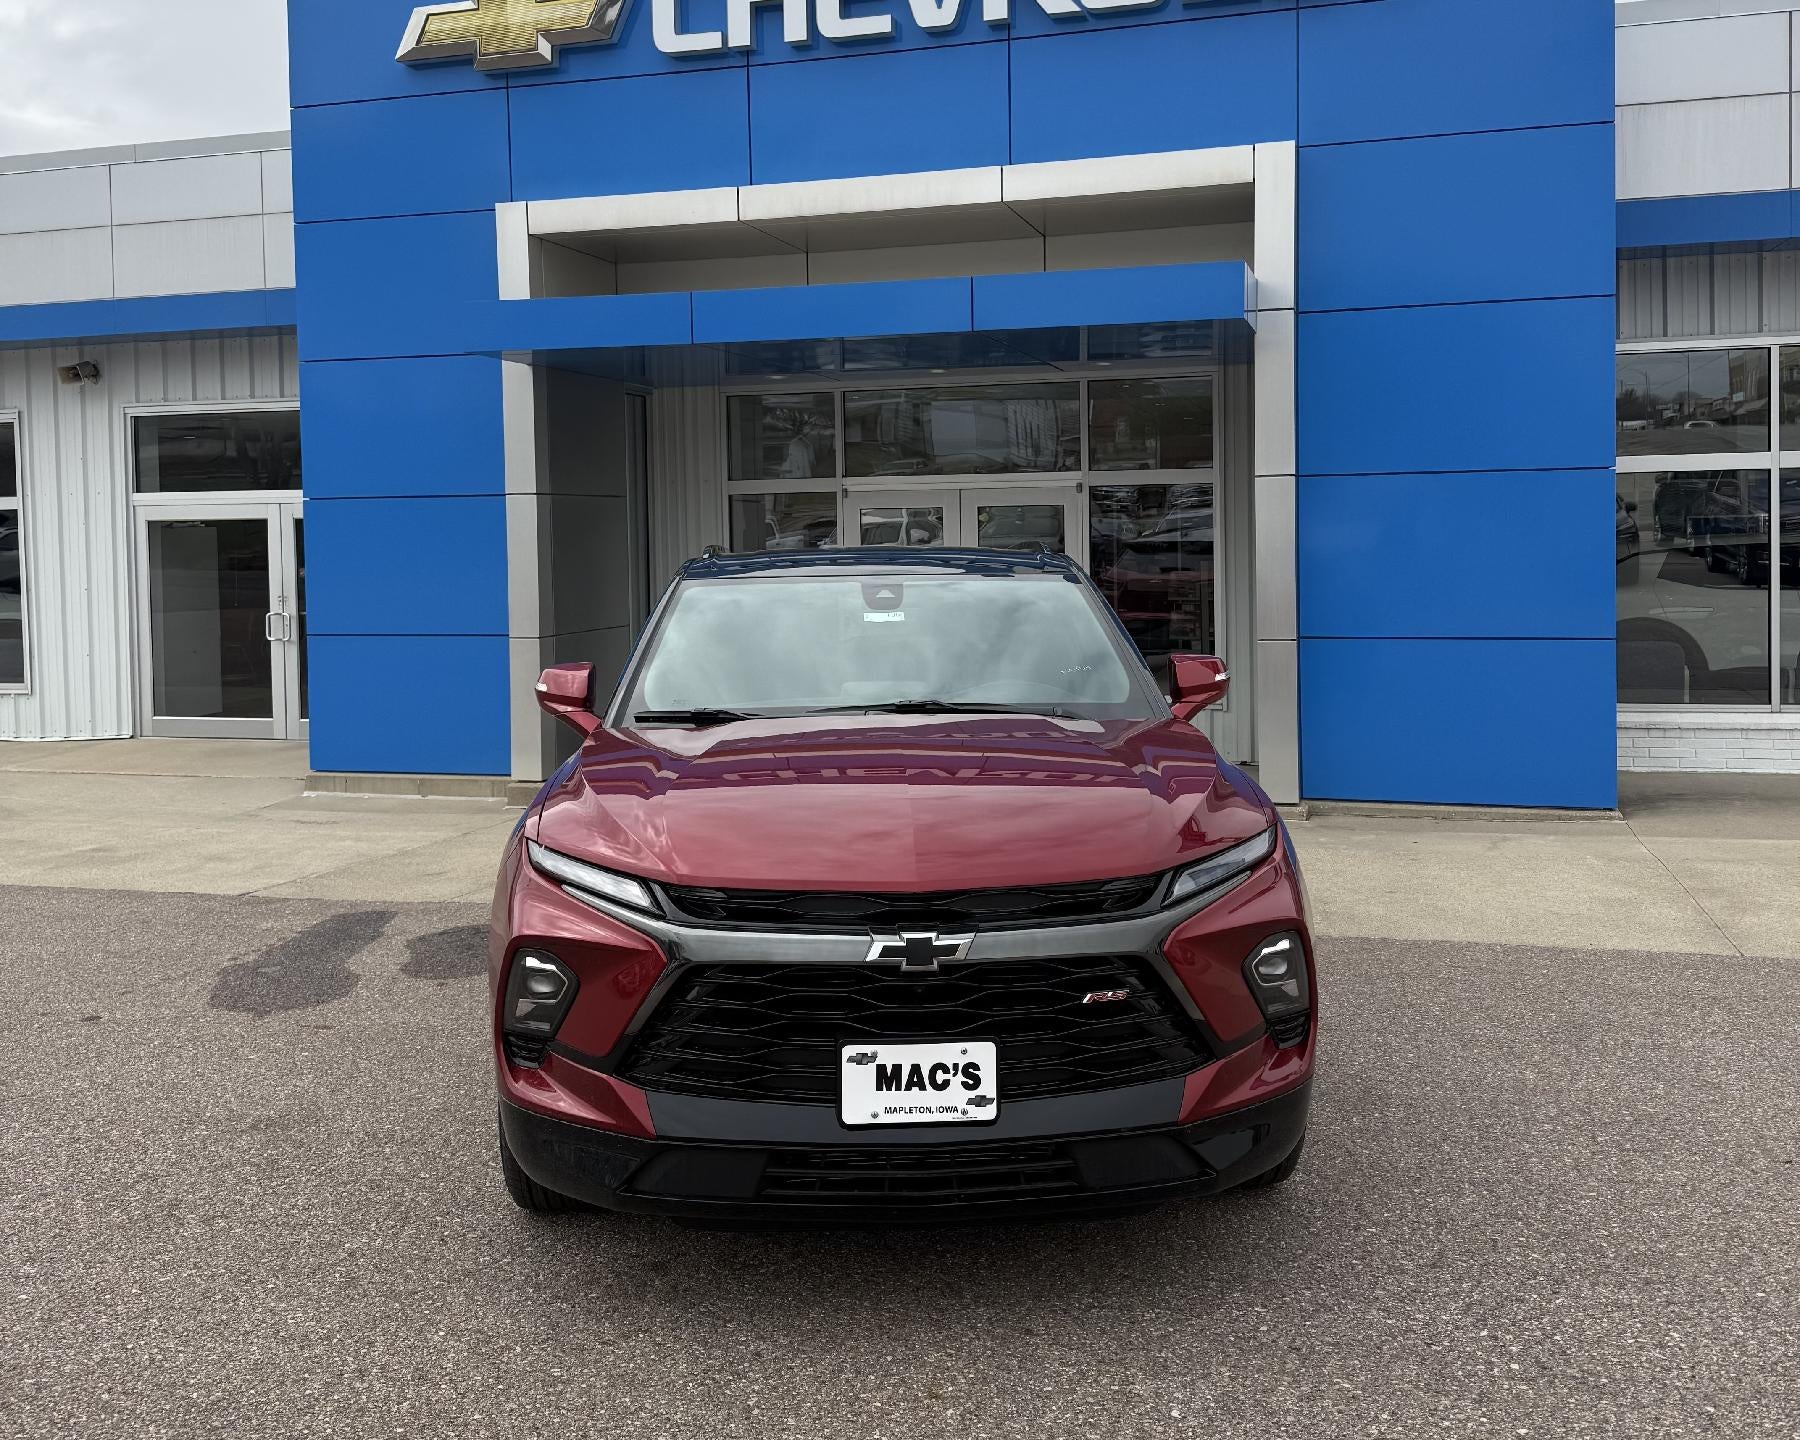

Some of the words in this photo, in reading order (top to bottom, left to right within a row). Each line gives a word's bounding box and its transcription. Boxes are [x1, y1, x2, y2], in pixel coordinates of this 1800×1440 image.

[1082, 990, 1130, 1004] RS
[875, 1061, 982, 1092] MAC'S
[884, 1106, 935, 1115] MAPLETON,
[935, 1105, 959, 1114] IOWA
